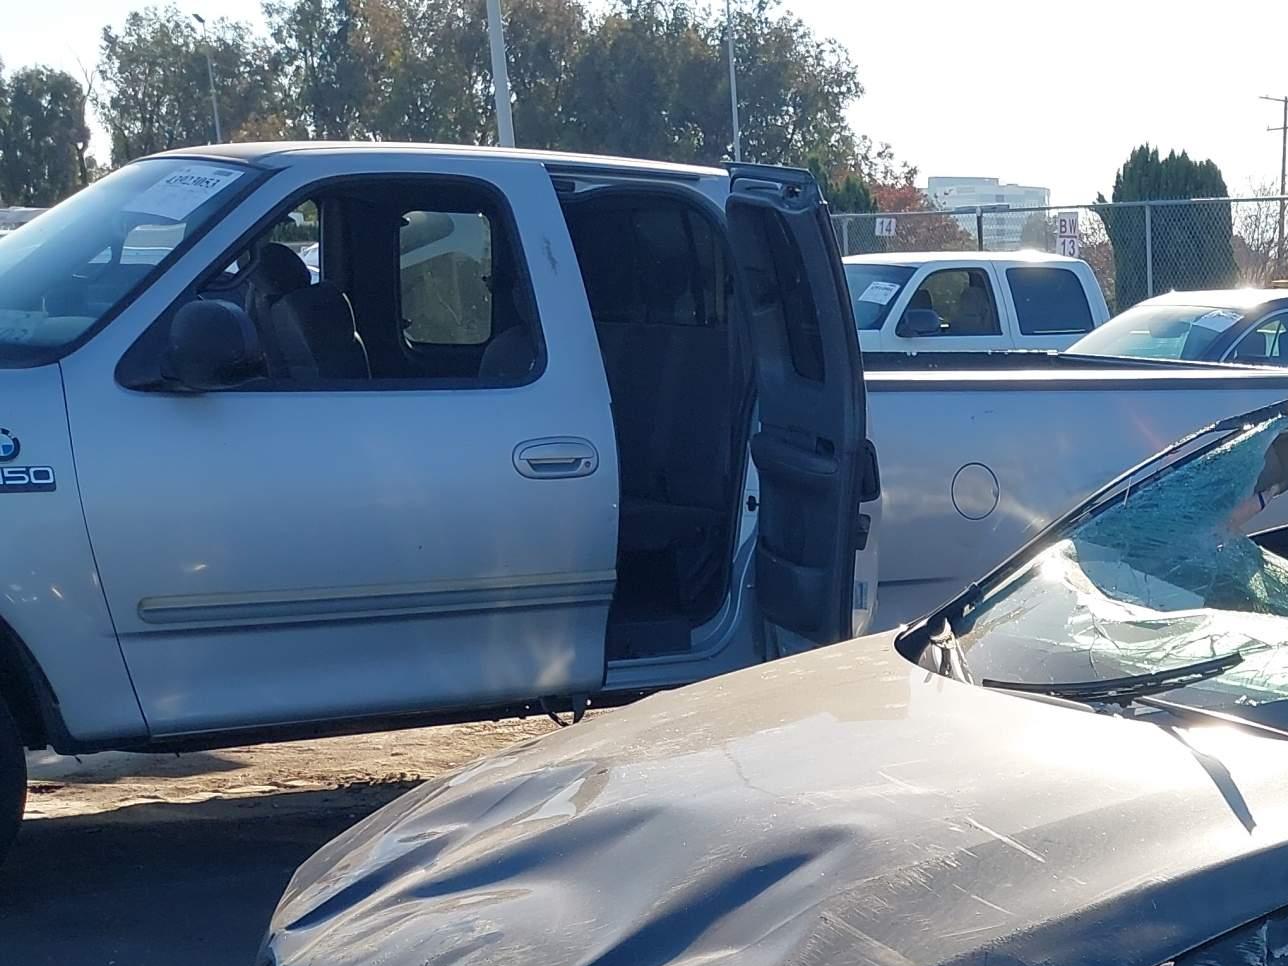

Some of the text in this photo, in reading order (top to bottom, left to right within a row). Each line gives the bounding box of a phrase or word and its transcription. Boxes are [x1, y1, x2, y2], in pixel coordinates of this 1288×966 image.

[880, 219, 892, 235] 14
[1060, 219, 1077, 234] BW
[1061, 239, 1076, 257] 13
